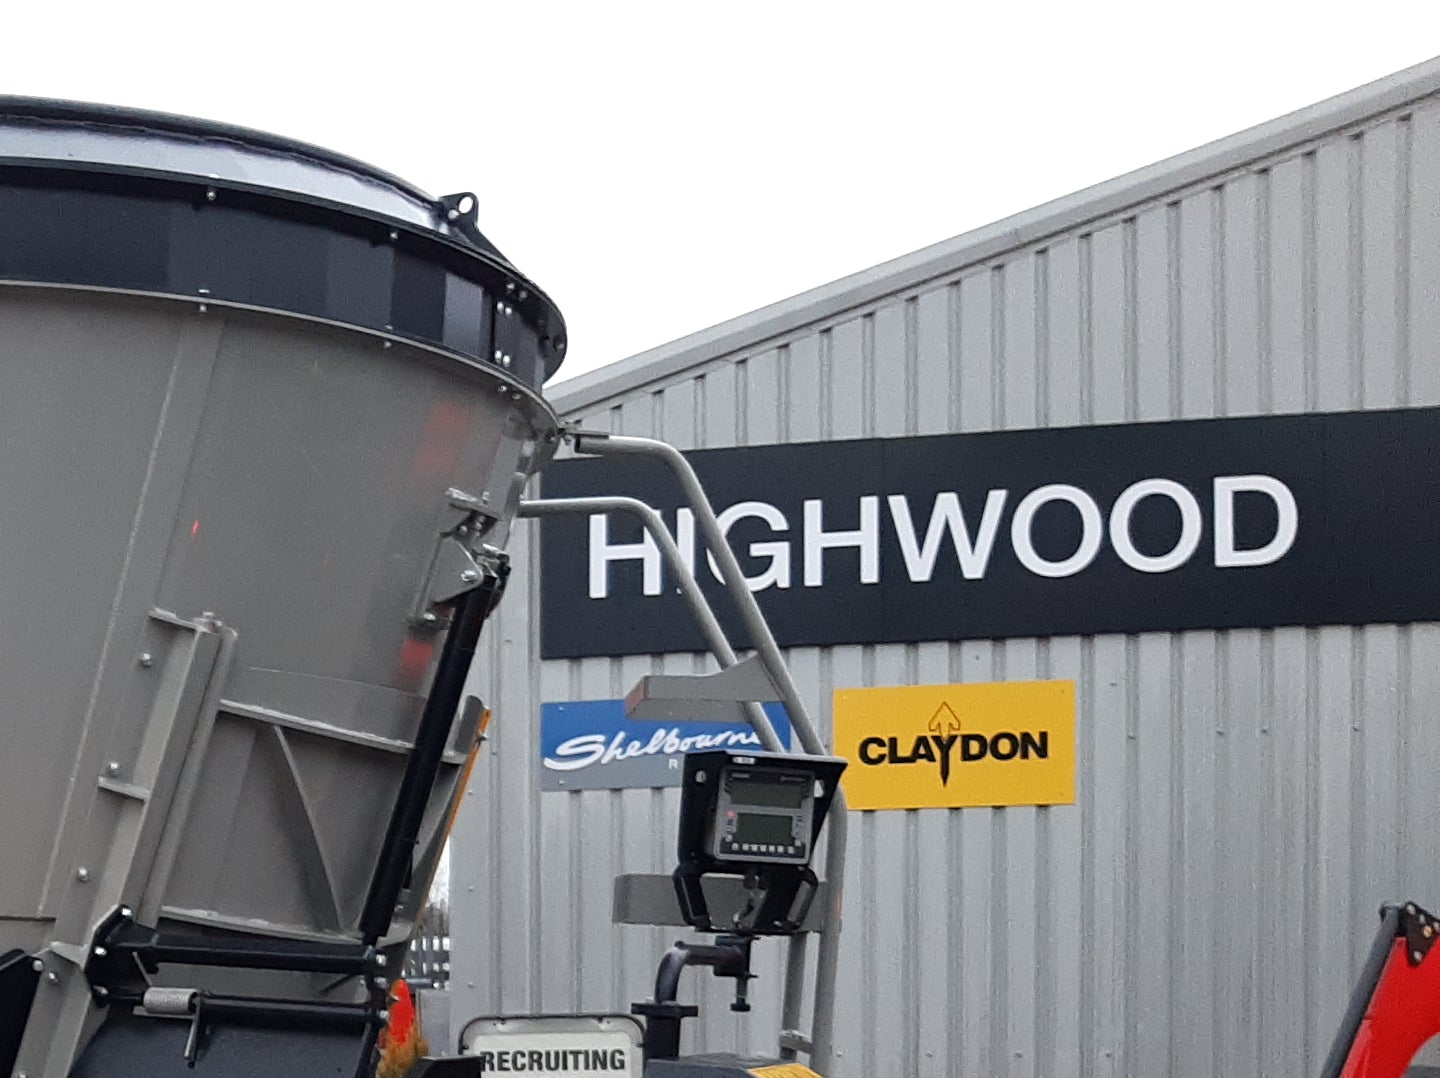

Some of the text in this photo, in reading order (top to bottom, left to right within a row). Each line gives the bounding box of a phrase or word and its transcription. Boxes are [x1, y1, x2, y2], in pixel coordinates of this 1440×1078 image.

[588, 474, 1299, 600] HIGHWOOD
[858, 731, 1049, 788] CLAYDON
[480, 1049, 626, 1073] RECRUITING
